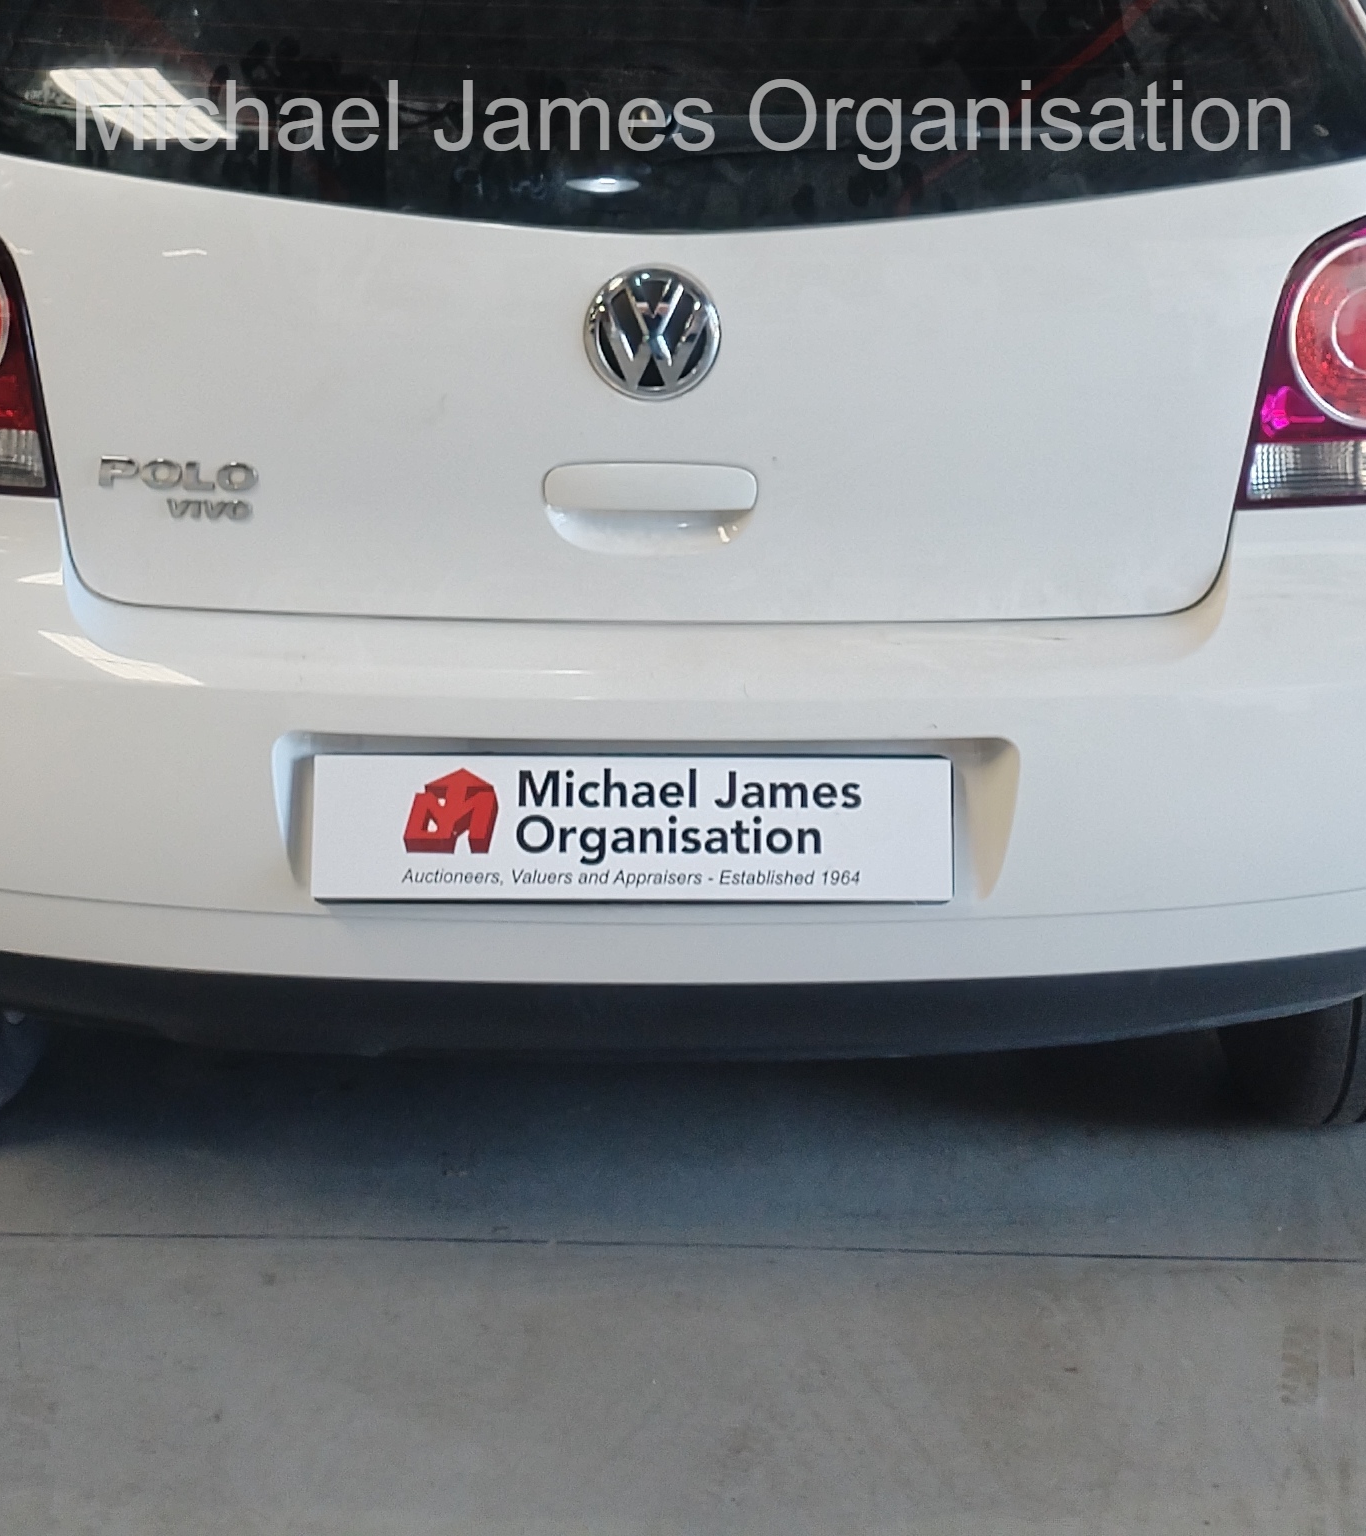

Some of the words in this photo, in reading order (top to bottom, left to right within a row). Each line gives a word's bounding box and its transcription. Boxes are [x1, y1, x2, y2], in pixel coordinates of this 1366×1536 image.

[98, 454, 259, 492] POLO
[166, 498, 253, 521] VIVO
[518, 767, 697, 809] Michael
[714, 770, 862, 810] James
[515, 814, 822, 866] Organisation
[401, 867, 504, 887] Auctioneers,
[511, 868, 573, 885] Valuers
[577, 869, 611, 885] and
[612, 869, 703, 889] Appraisers
[718, 869, 816, 886] Established
[821, 869, 861, 886] 1964
